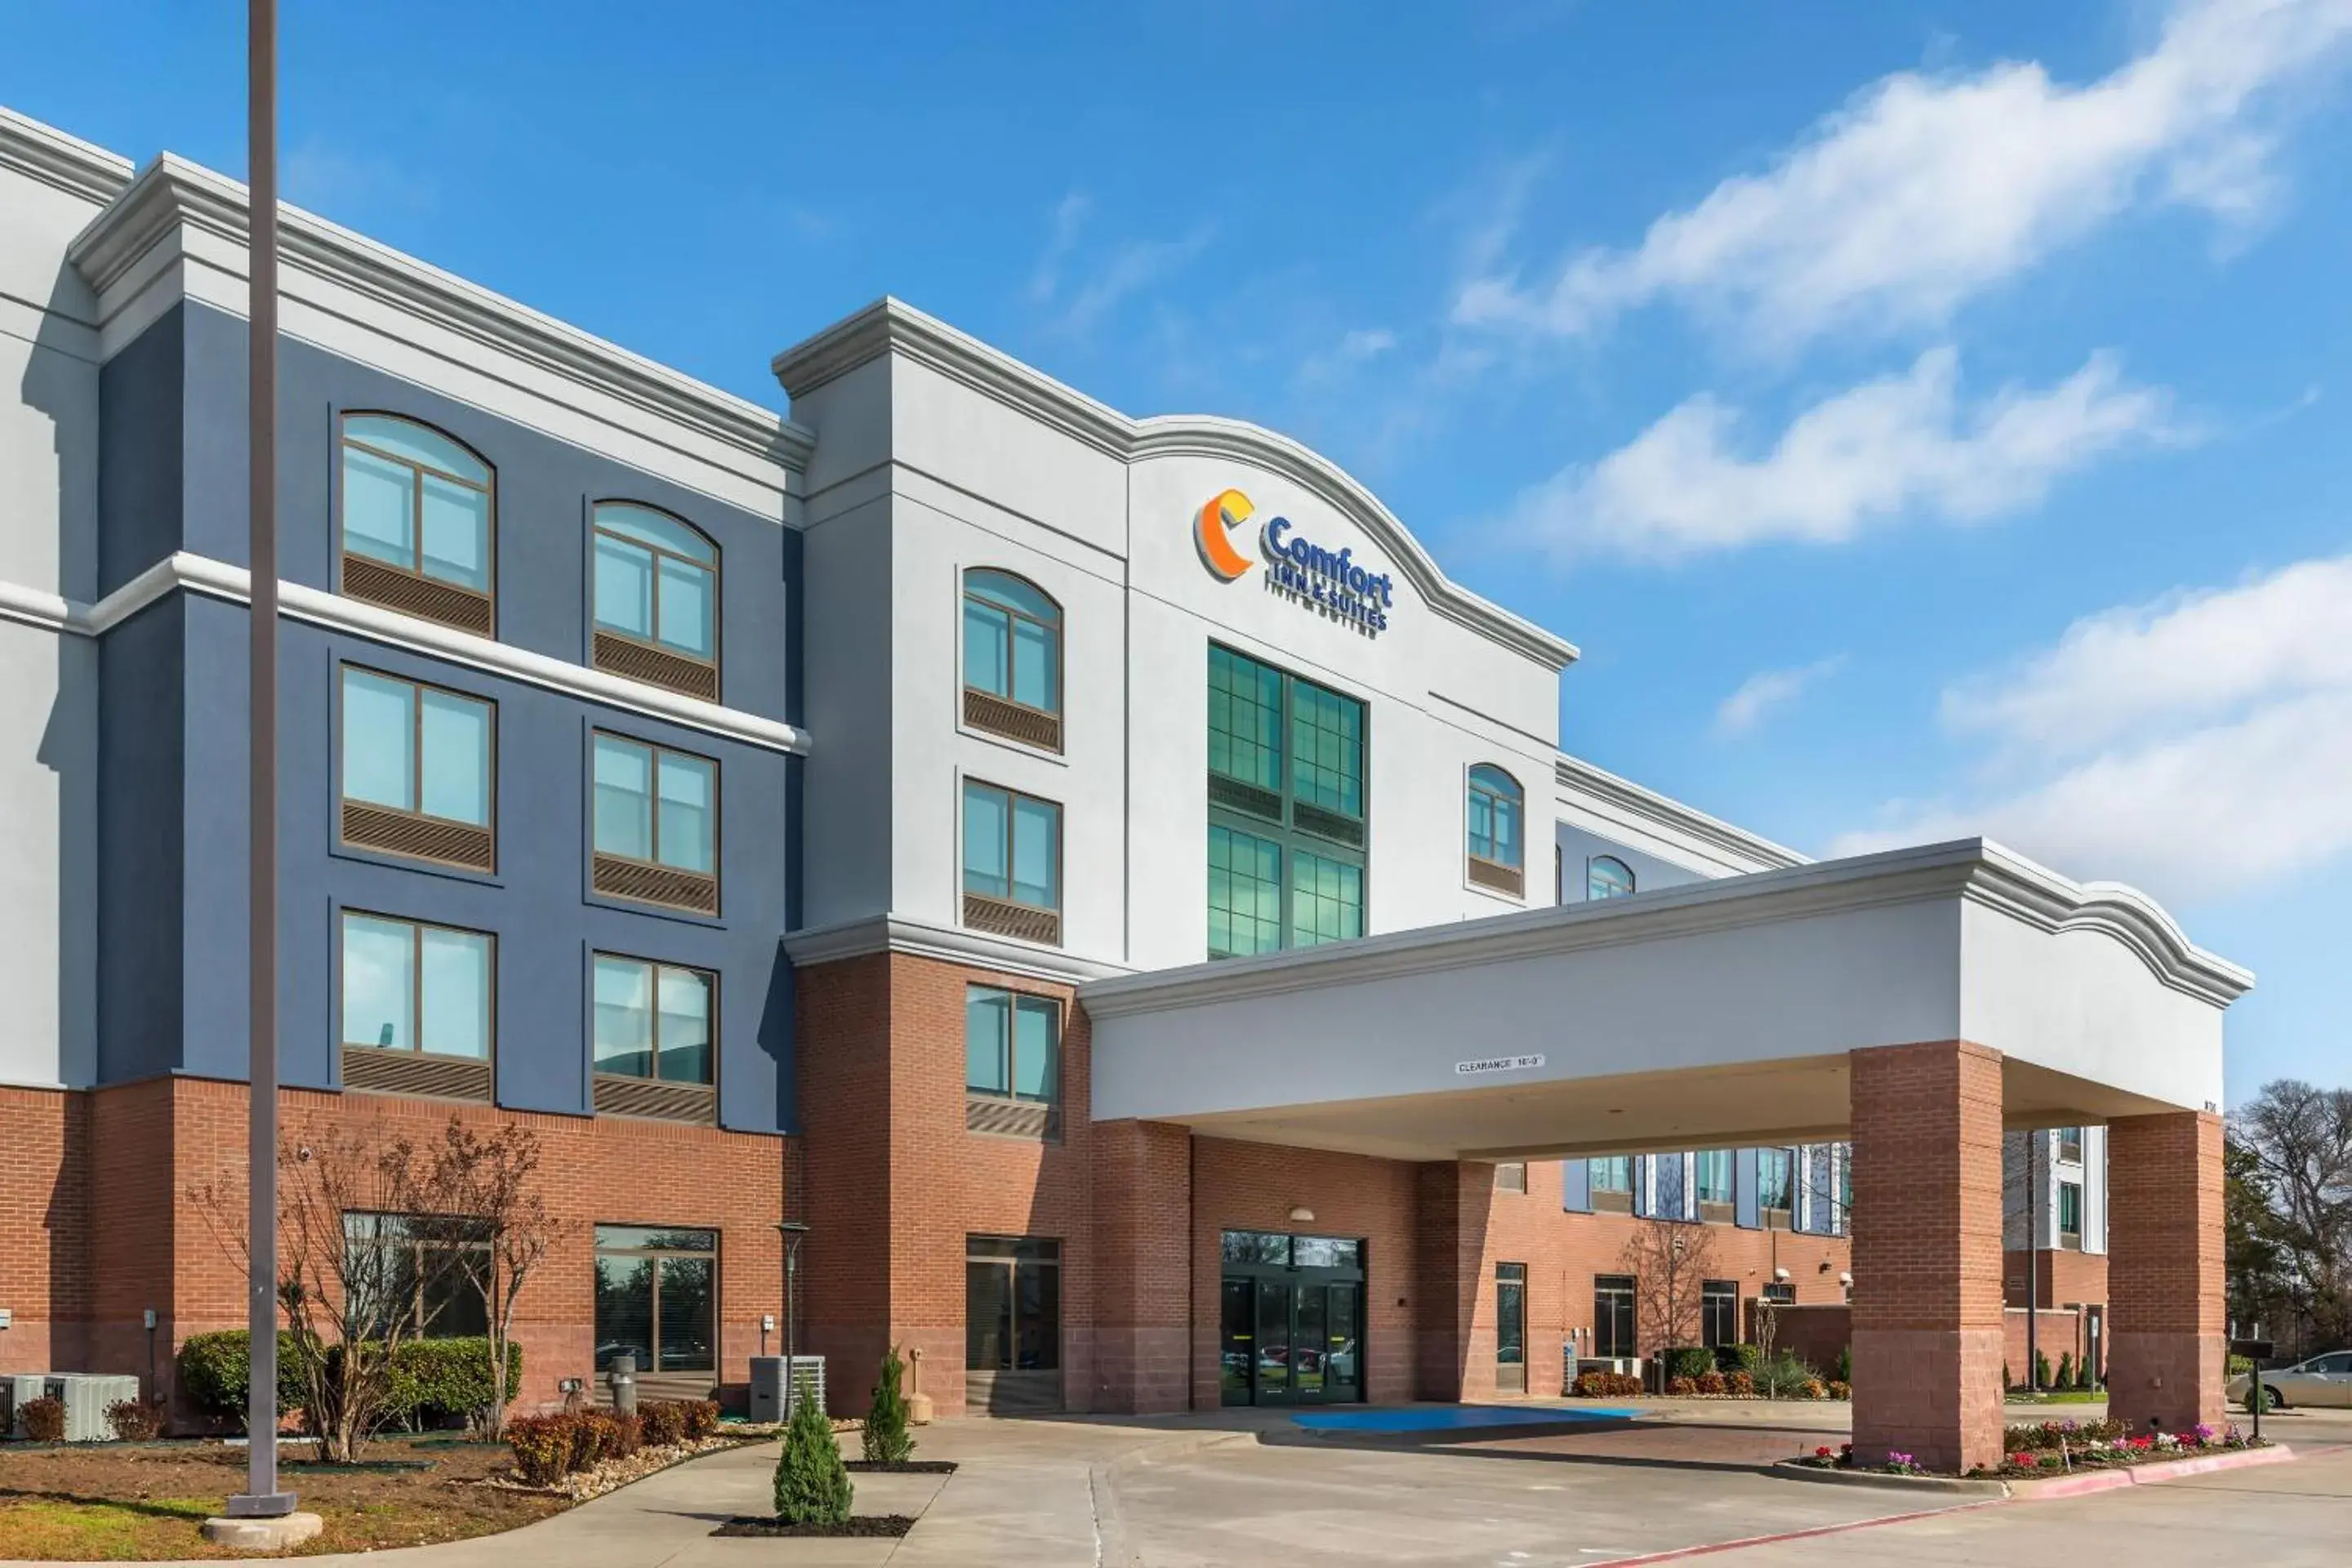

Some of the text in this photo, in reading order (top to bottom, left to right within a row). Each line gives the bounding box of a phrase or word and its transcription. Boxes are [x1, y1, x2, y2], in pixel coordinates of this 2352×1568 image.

[1267, 516, 1392, 608] Comfort
[1273, 562, 1387, 631] INN & SUITES
[1459, 1059, 1511, 1072] CLEARANCE
